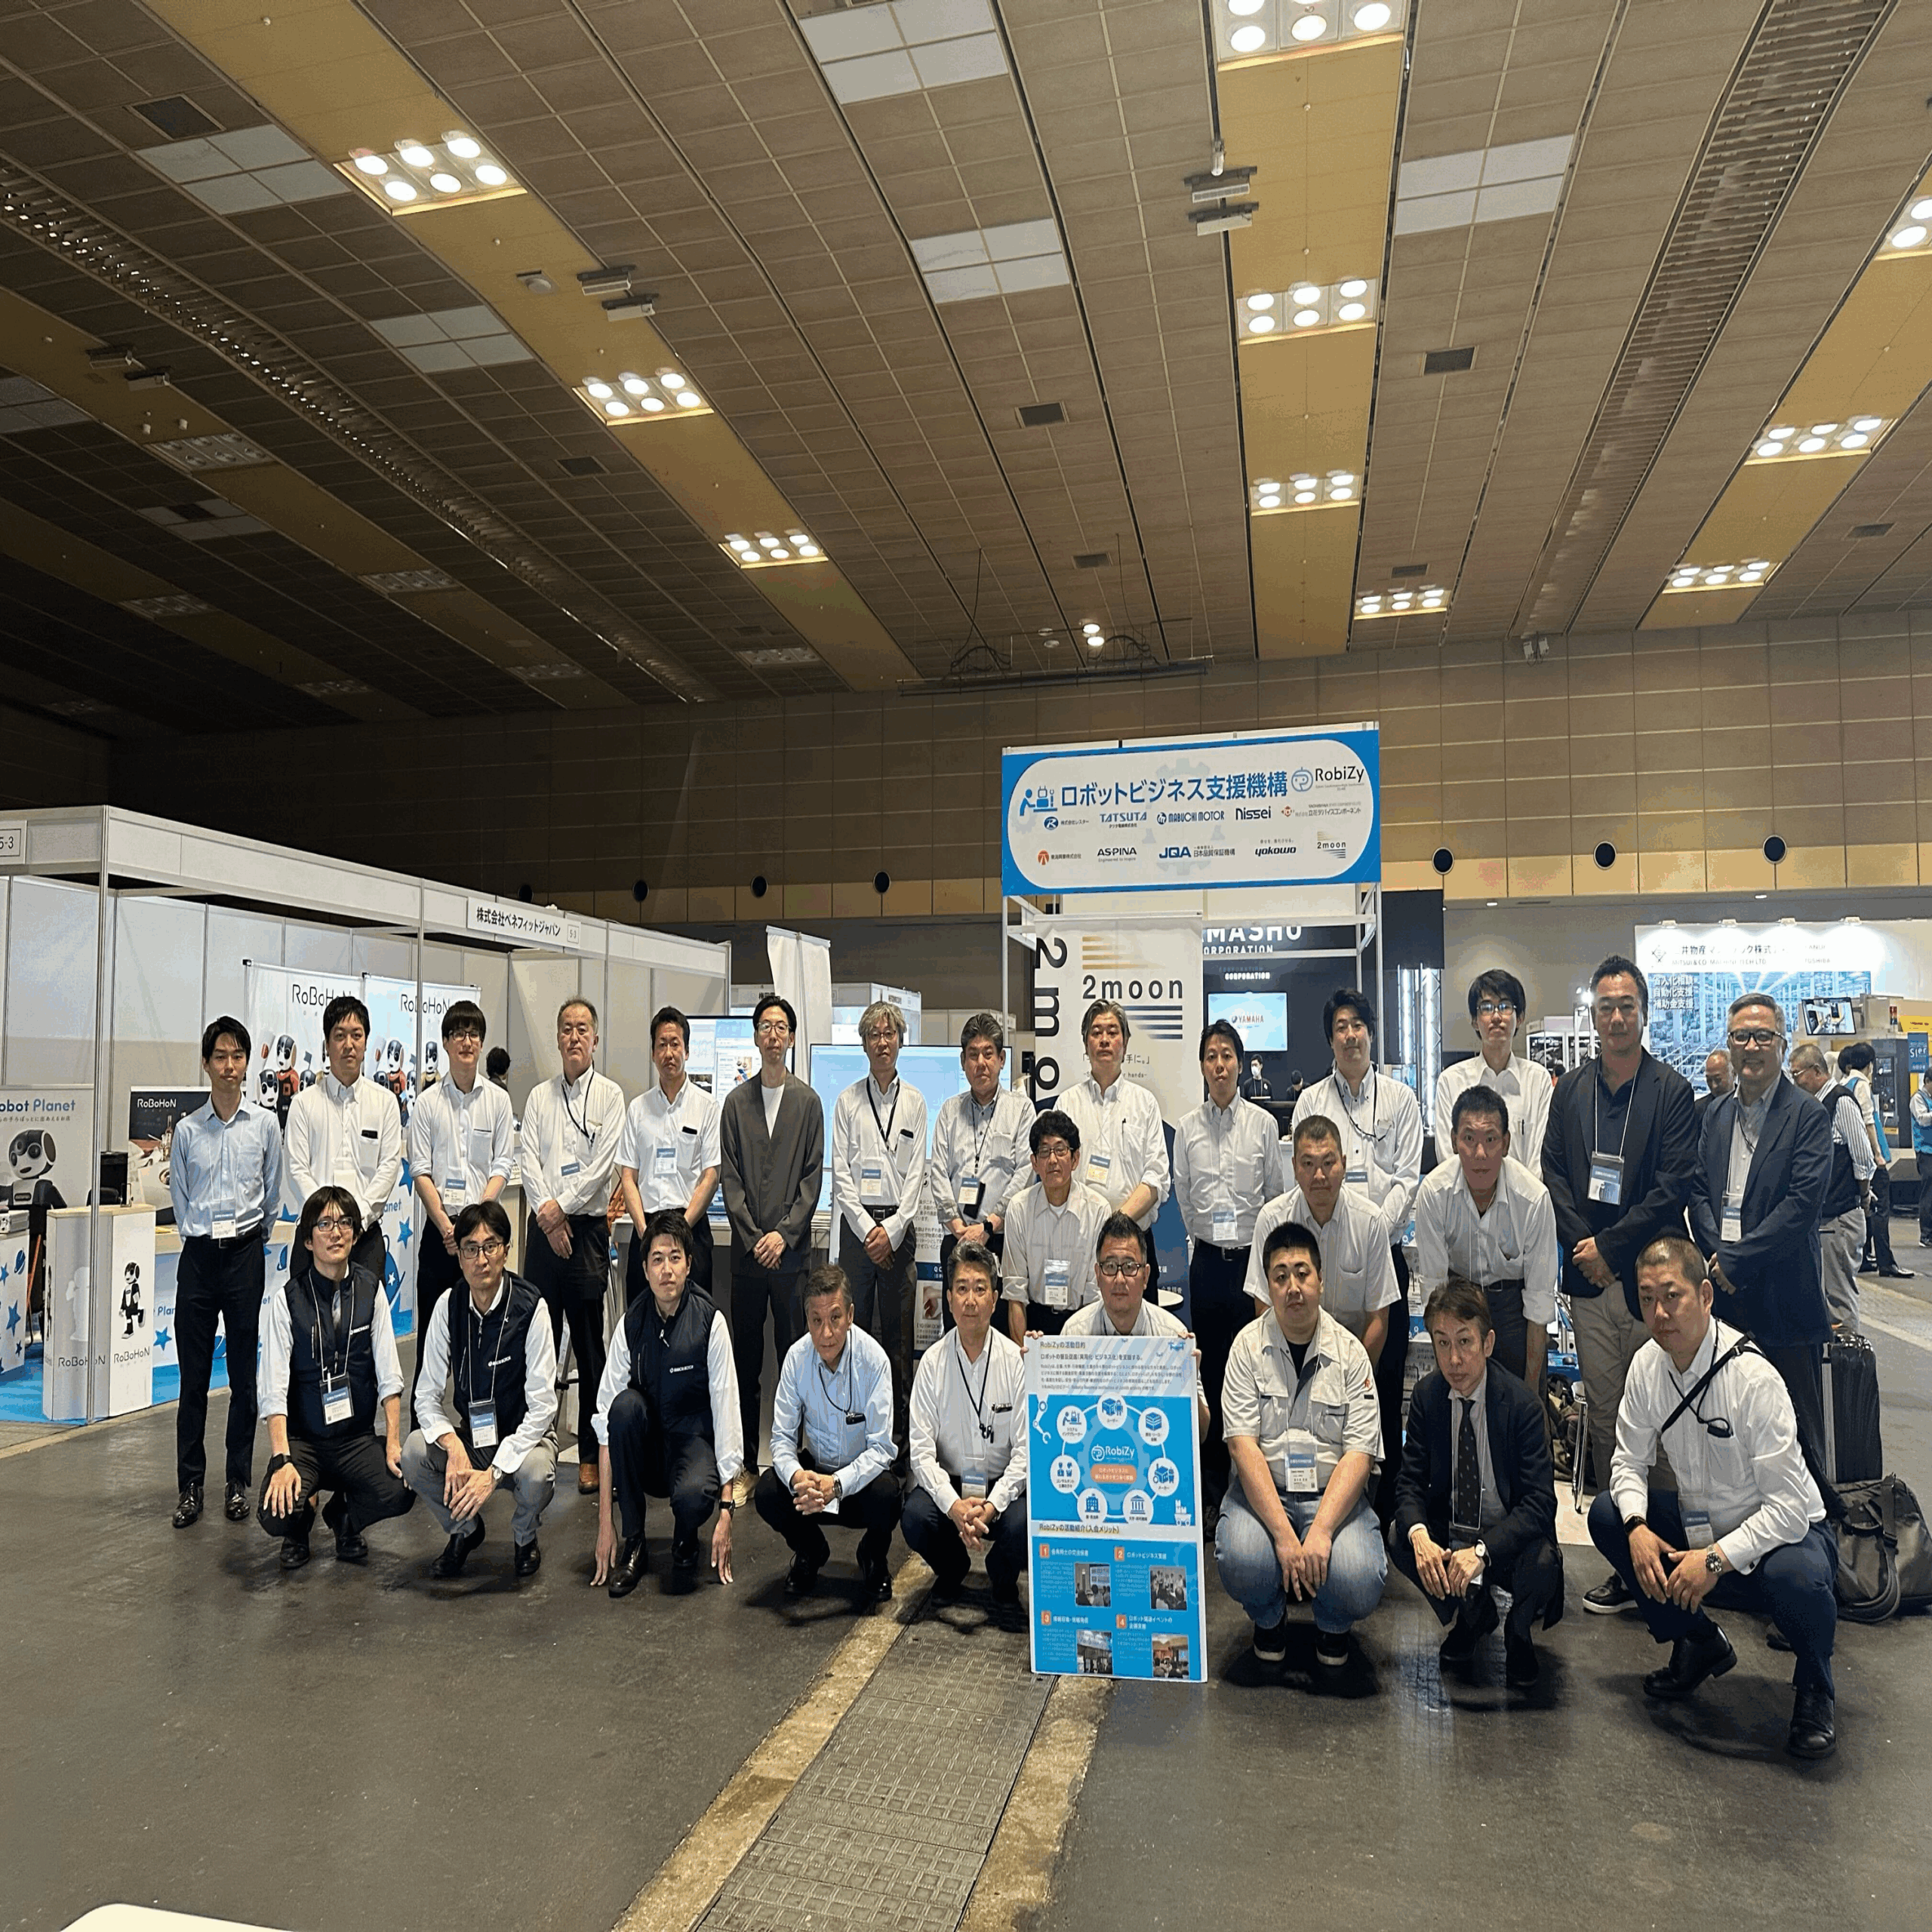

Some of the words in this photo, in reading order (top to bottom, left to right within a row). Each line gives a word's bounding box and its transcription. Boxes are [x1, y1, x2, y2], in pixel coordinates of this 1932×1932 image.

[1315, 766, 1364, 783] RobiZy
[1062, 771, 1287, 806] ロボットビジネス支援機構
[1100, 811, 1147, 823] TATSUTA
[1168, 812, 1196, 823] MABUCHI
[1198, 811, 1224, 822] MOTOR
[1097, 847, 1137, 857] ASPINA
[1158, 846, 1192, 859] JQA
[1193, 848, 1235, 857] 日本品質保証機構
[1255, 846, 1297, 857] yokowo
[476, 906, 561, 937] 株式会社ベネフィットジャパン
[1202, 925, 1302, 943] MASHO
[1203, 945, 1273, 955] ORPORATION
[1082, 974, 1183, 1000] 2moon
[401, 993, 451, 1015] RooHoN
[1238, 1014, 1264, 1023] YAMAHA
[0, 1099, 29, 1112] obot
[33, 1098, 75, 1112] Planet
[137, 1098, 177, 1109] RoBoHoN
[383, 1198, 402, 1213] anet
[1040, 1341, 1086, 1349] RobiZyの活動目的
[113, 1346, 150, 1364] RoBoHoN
[1105, 1444, 1135, 1458] RobiZy
[1118, 1549, 1123, 1558] 2
[1044, 1614, 1050, 1623] 3
